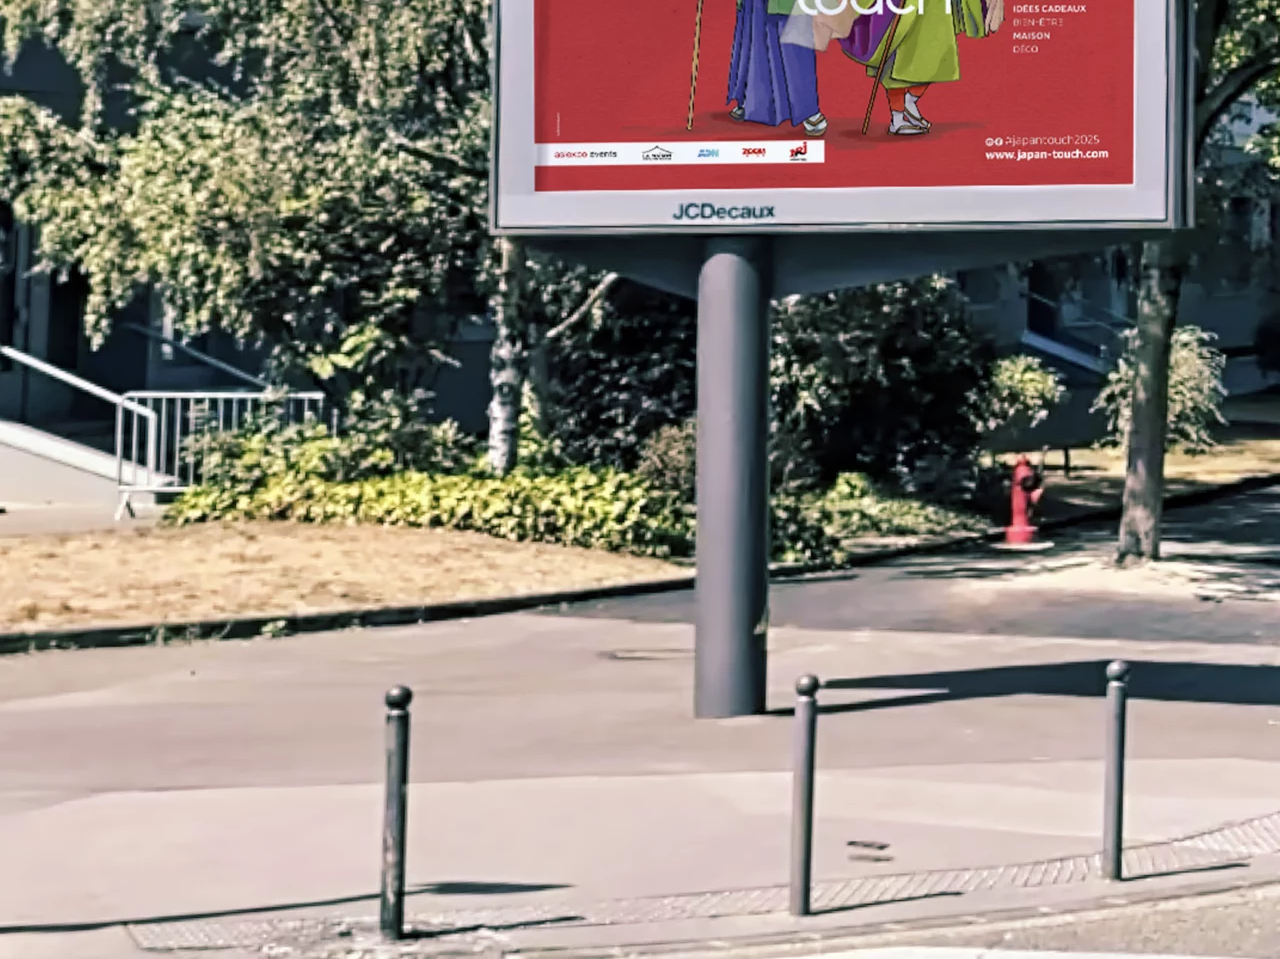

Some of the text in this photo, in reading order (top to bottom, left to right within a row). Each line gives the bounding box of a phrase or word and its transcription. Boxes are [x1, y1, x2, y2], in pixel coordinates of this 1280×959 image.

[1013, 3, 1087, 13] IDÉES CADEAUX
[1013, 31, 1051, 40] MAISON
[985, 149, 1109, 161] www.japan-touch.com
[673, 203, 775, 220] JCDecaux
